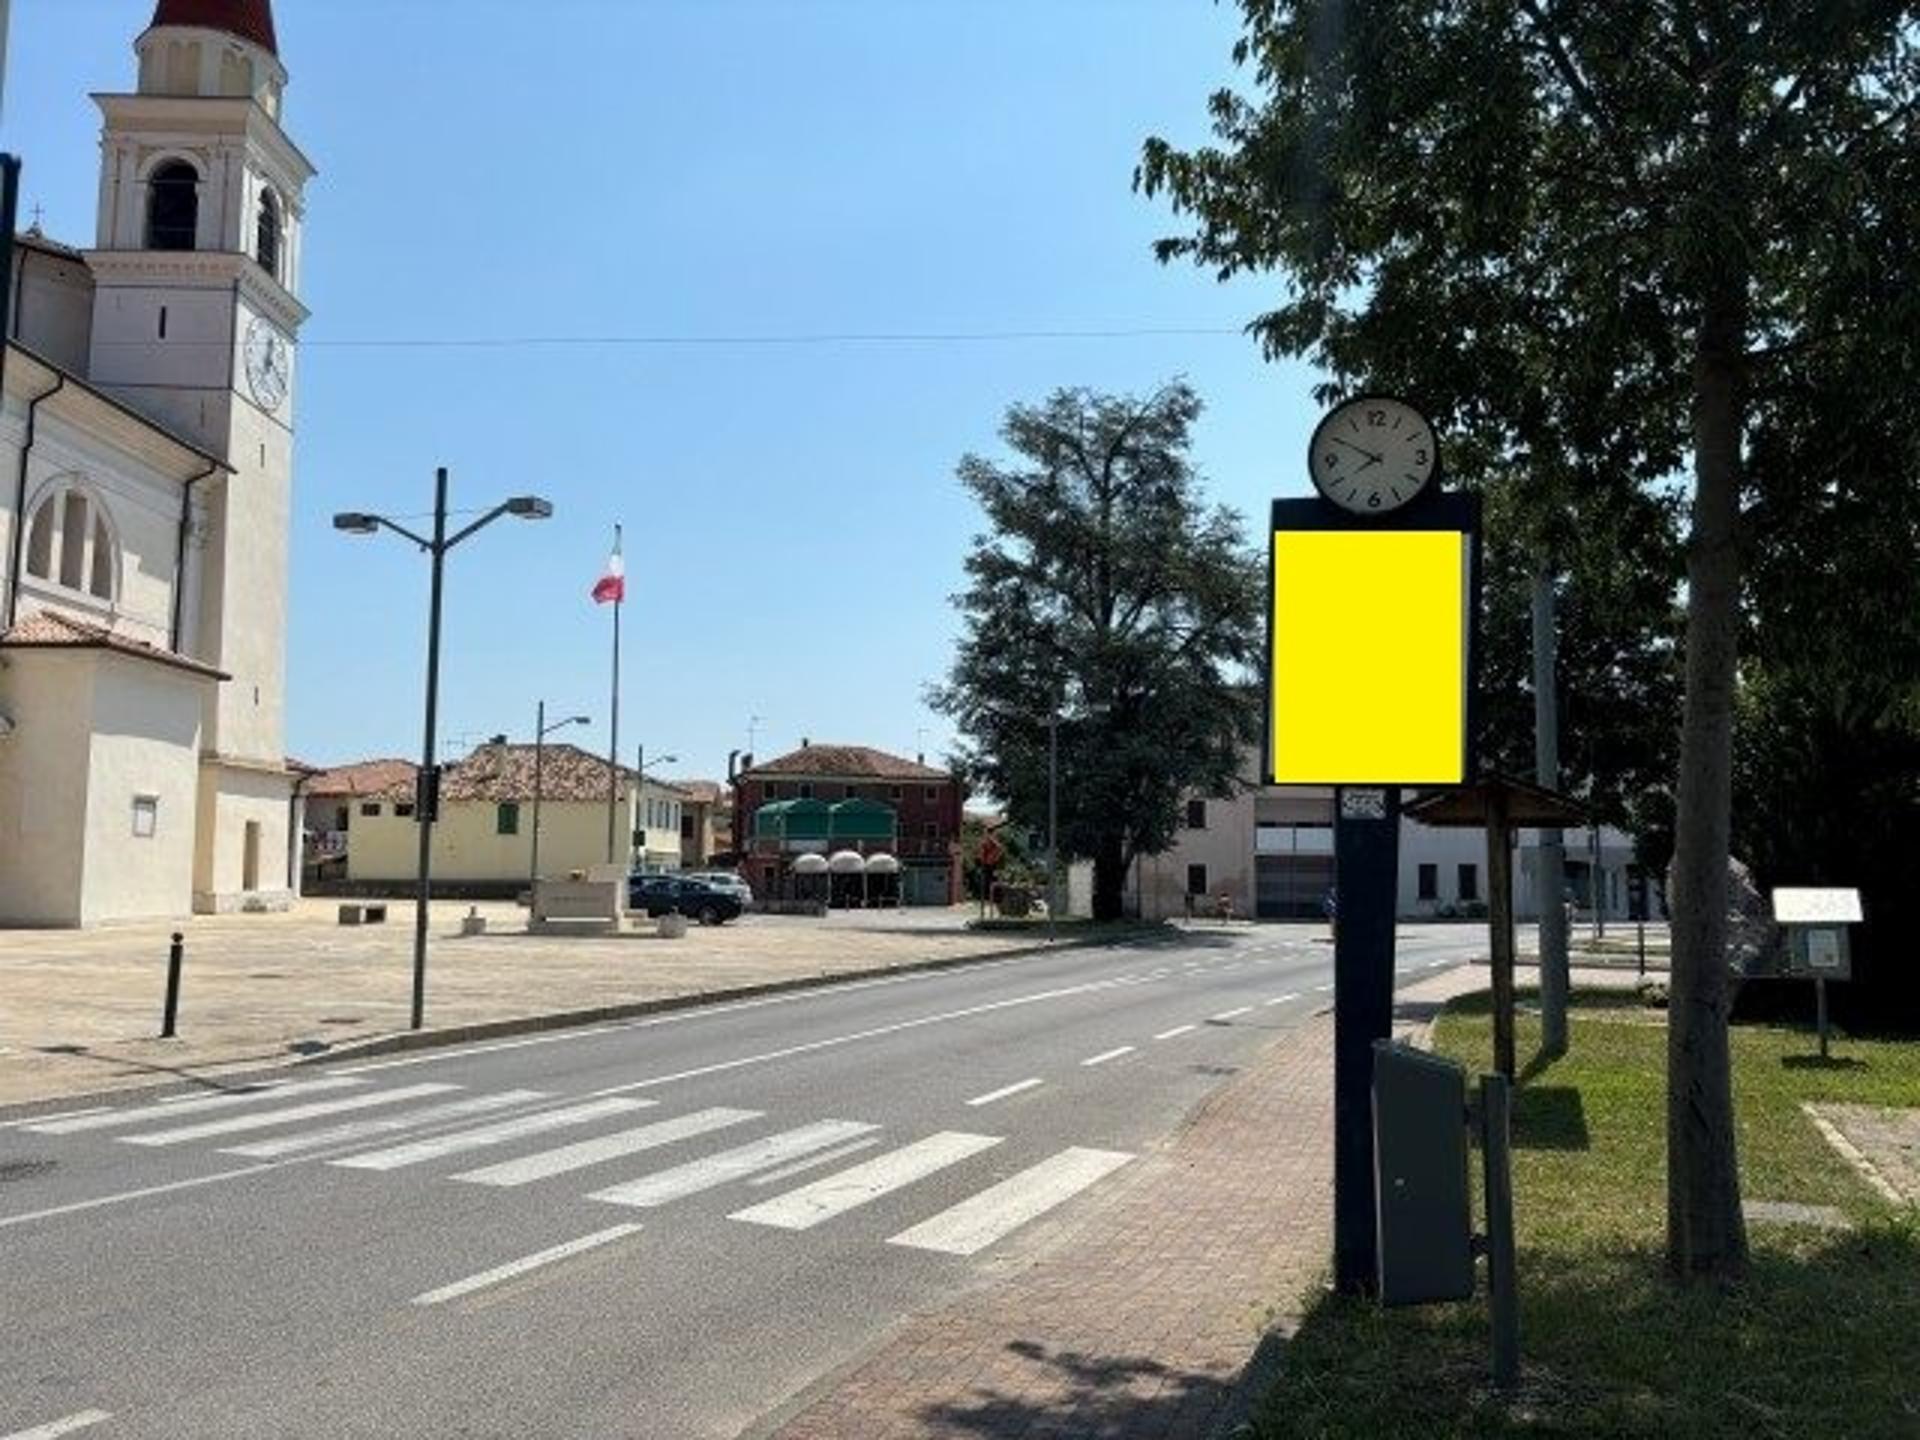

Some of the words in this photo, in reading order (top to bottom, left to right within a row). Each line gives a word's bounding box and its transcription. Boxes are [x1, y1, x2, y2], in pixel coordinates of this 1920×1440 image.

[1367, 410, 1387, 427] 12
[1325, 454, 1338, 468] 9
[1416, 449, 1428, 466] 3
[1367, 492, 1381, 508] 6
